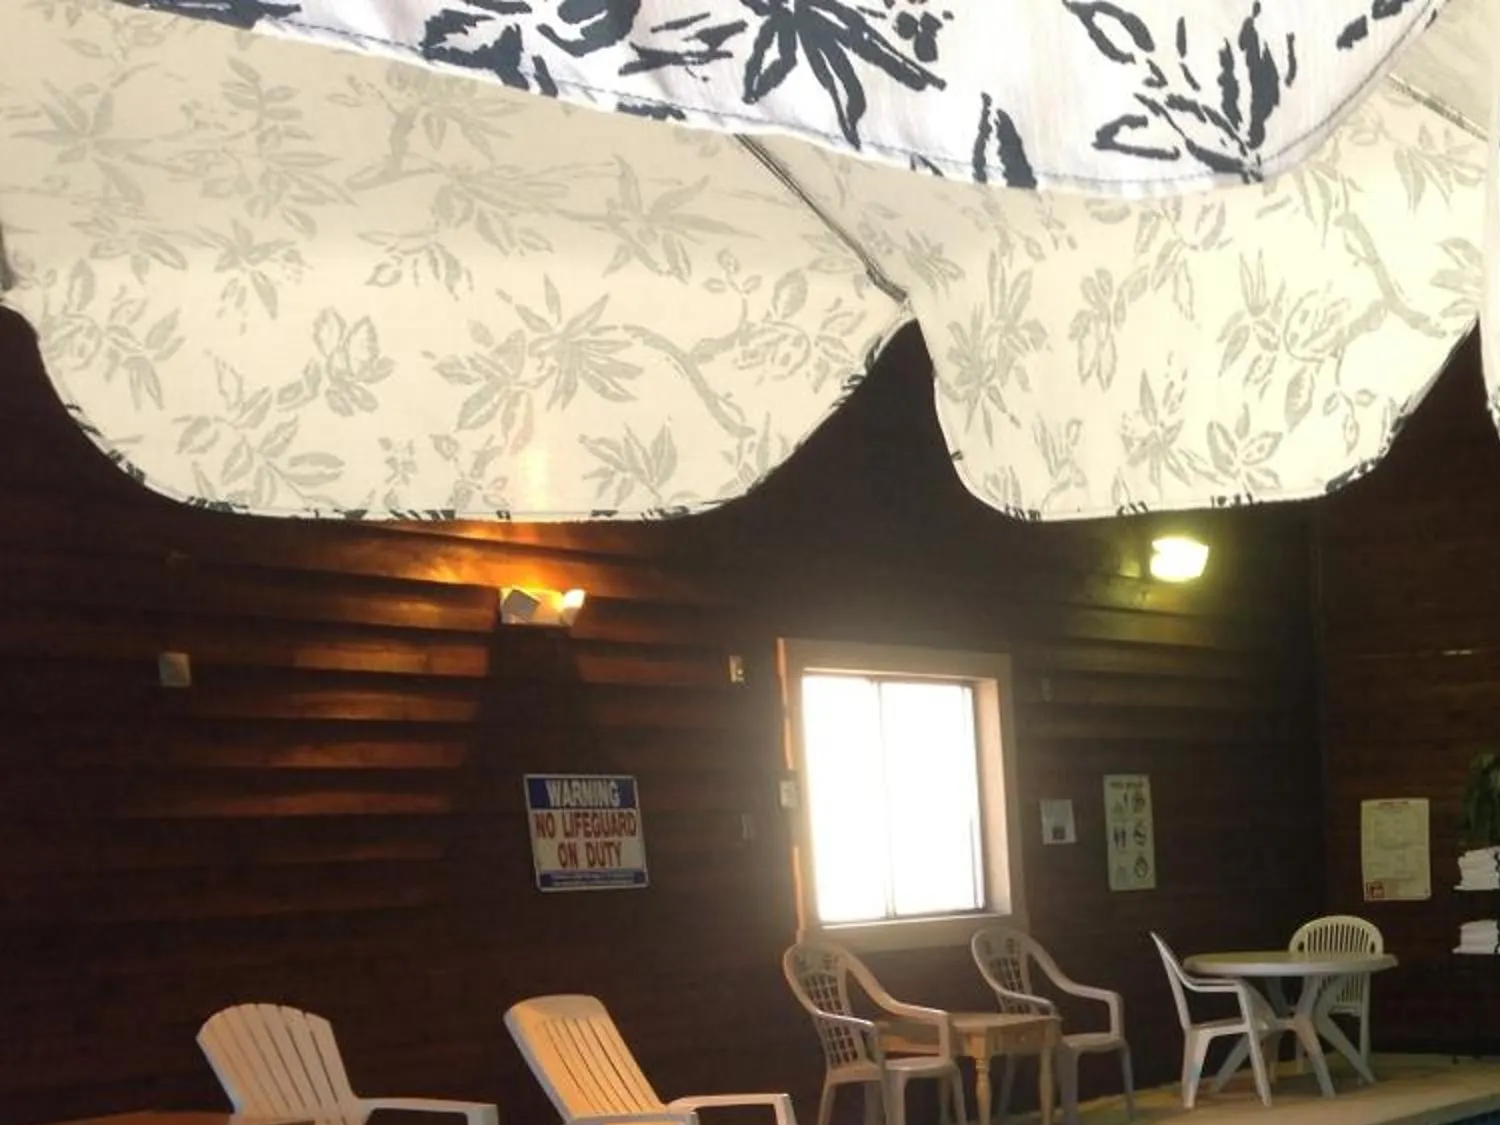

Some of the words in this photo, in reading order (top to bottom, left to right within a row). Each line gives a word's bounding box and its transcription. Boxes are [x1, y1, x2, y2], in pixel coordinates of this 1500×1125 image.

[545, 779, 621, 807] WARNING
[534, 811, 555, 839] NO
[562, 811, 636, 838] LIFEGUARD
[558, 841, 579, 868] ON
[586, 841, 622, 867] DUTY
